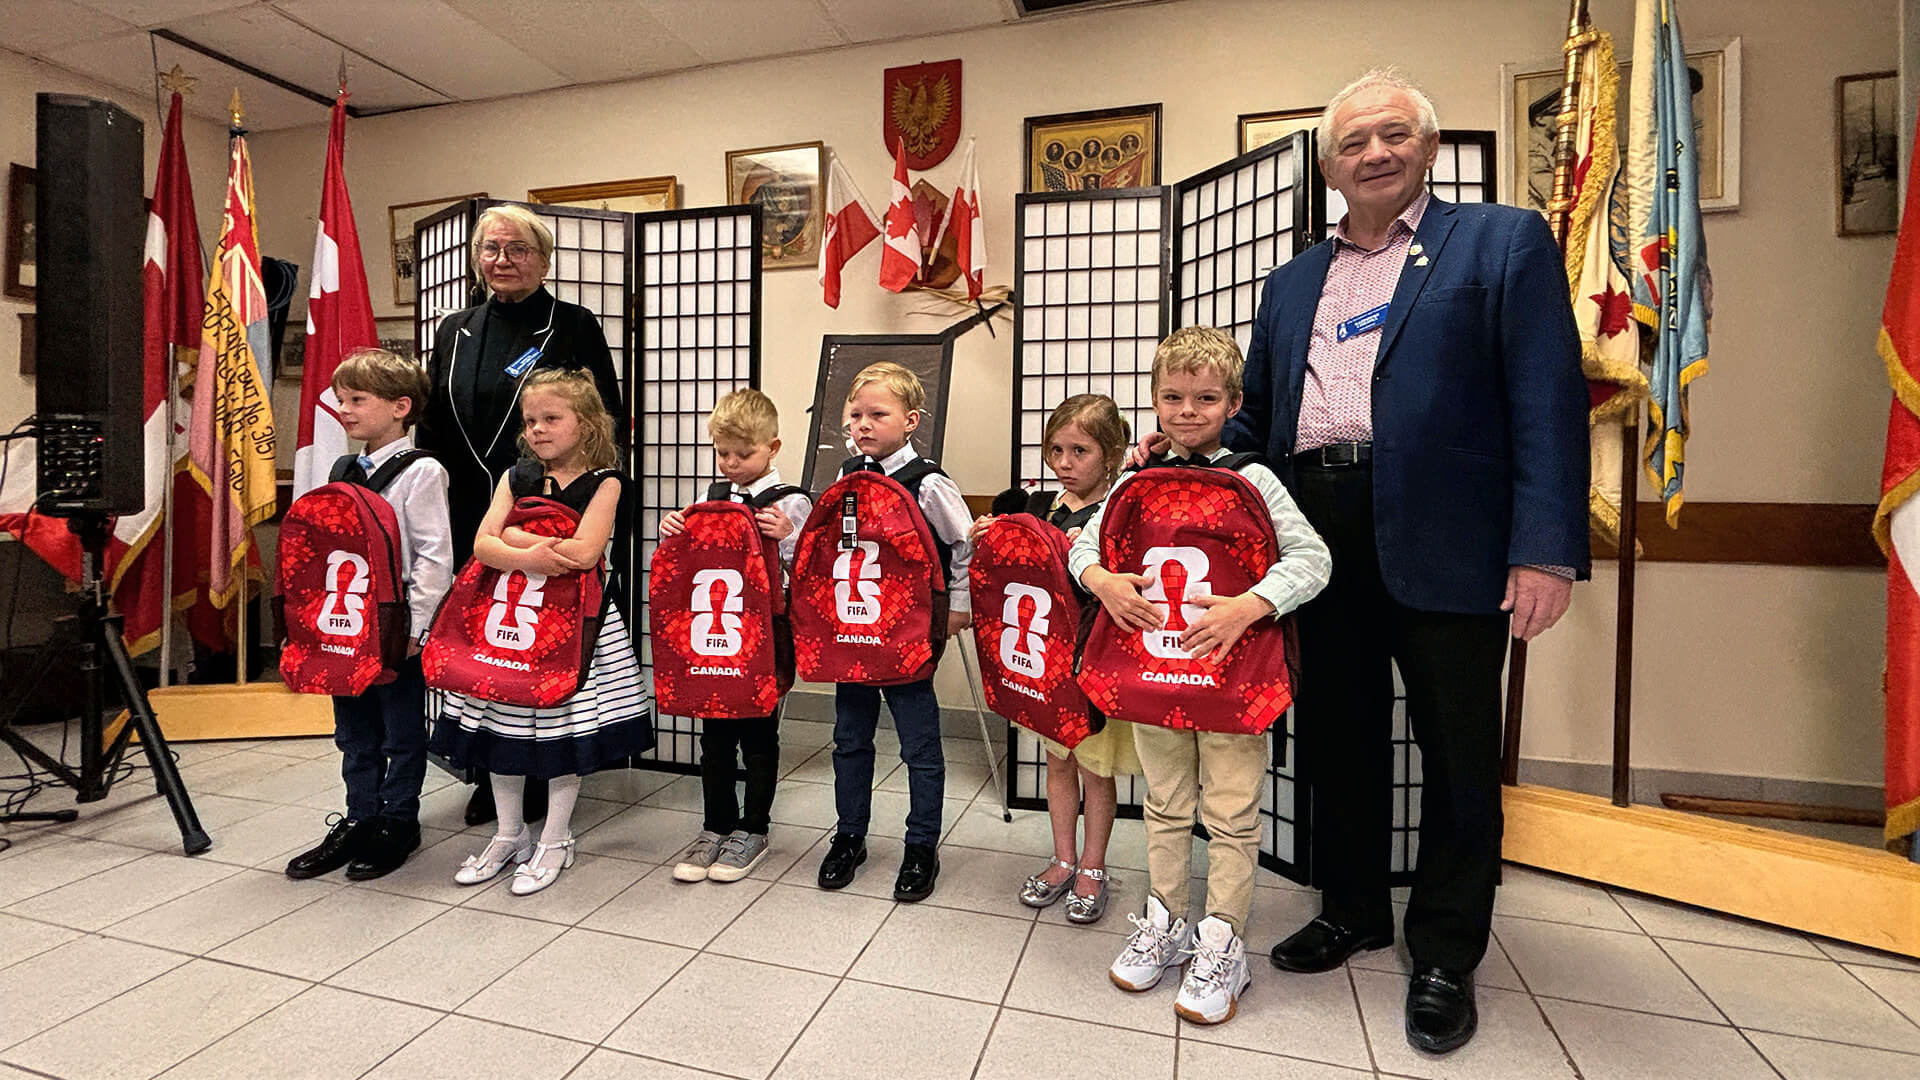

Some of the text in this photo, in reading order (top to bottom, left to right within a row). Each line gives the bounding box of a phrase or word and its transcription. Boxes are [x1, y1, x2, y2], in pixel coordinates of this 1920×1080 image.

[847, 606, 868, 616] FIFA
[329, 618, 351, 628] FIFA
[496, 629, 520, 642] FIFA
[836, 634, 882, 645] CANADA
[706, 638, 728, 648] FIFA
[473, 653, 530, 671] CANADA
[1011, 654, 1033, 669] FIFA
[690, 666, 741, 676] CANADA
[1141, 671, 1216, 687] CANADA
[1001, 678, 1046, 702] CANADA
